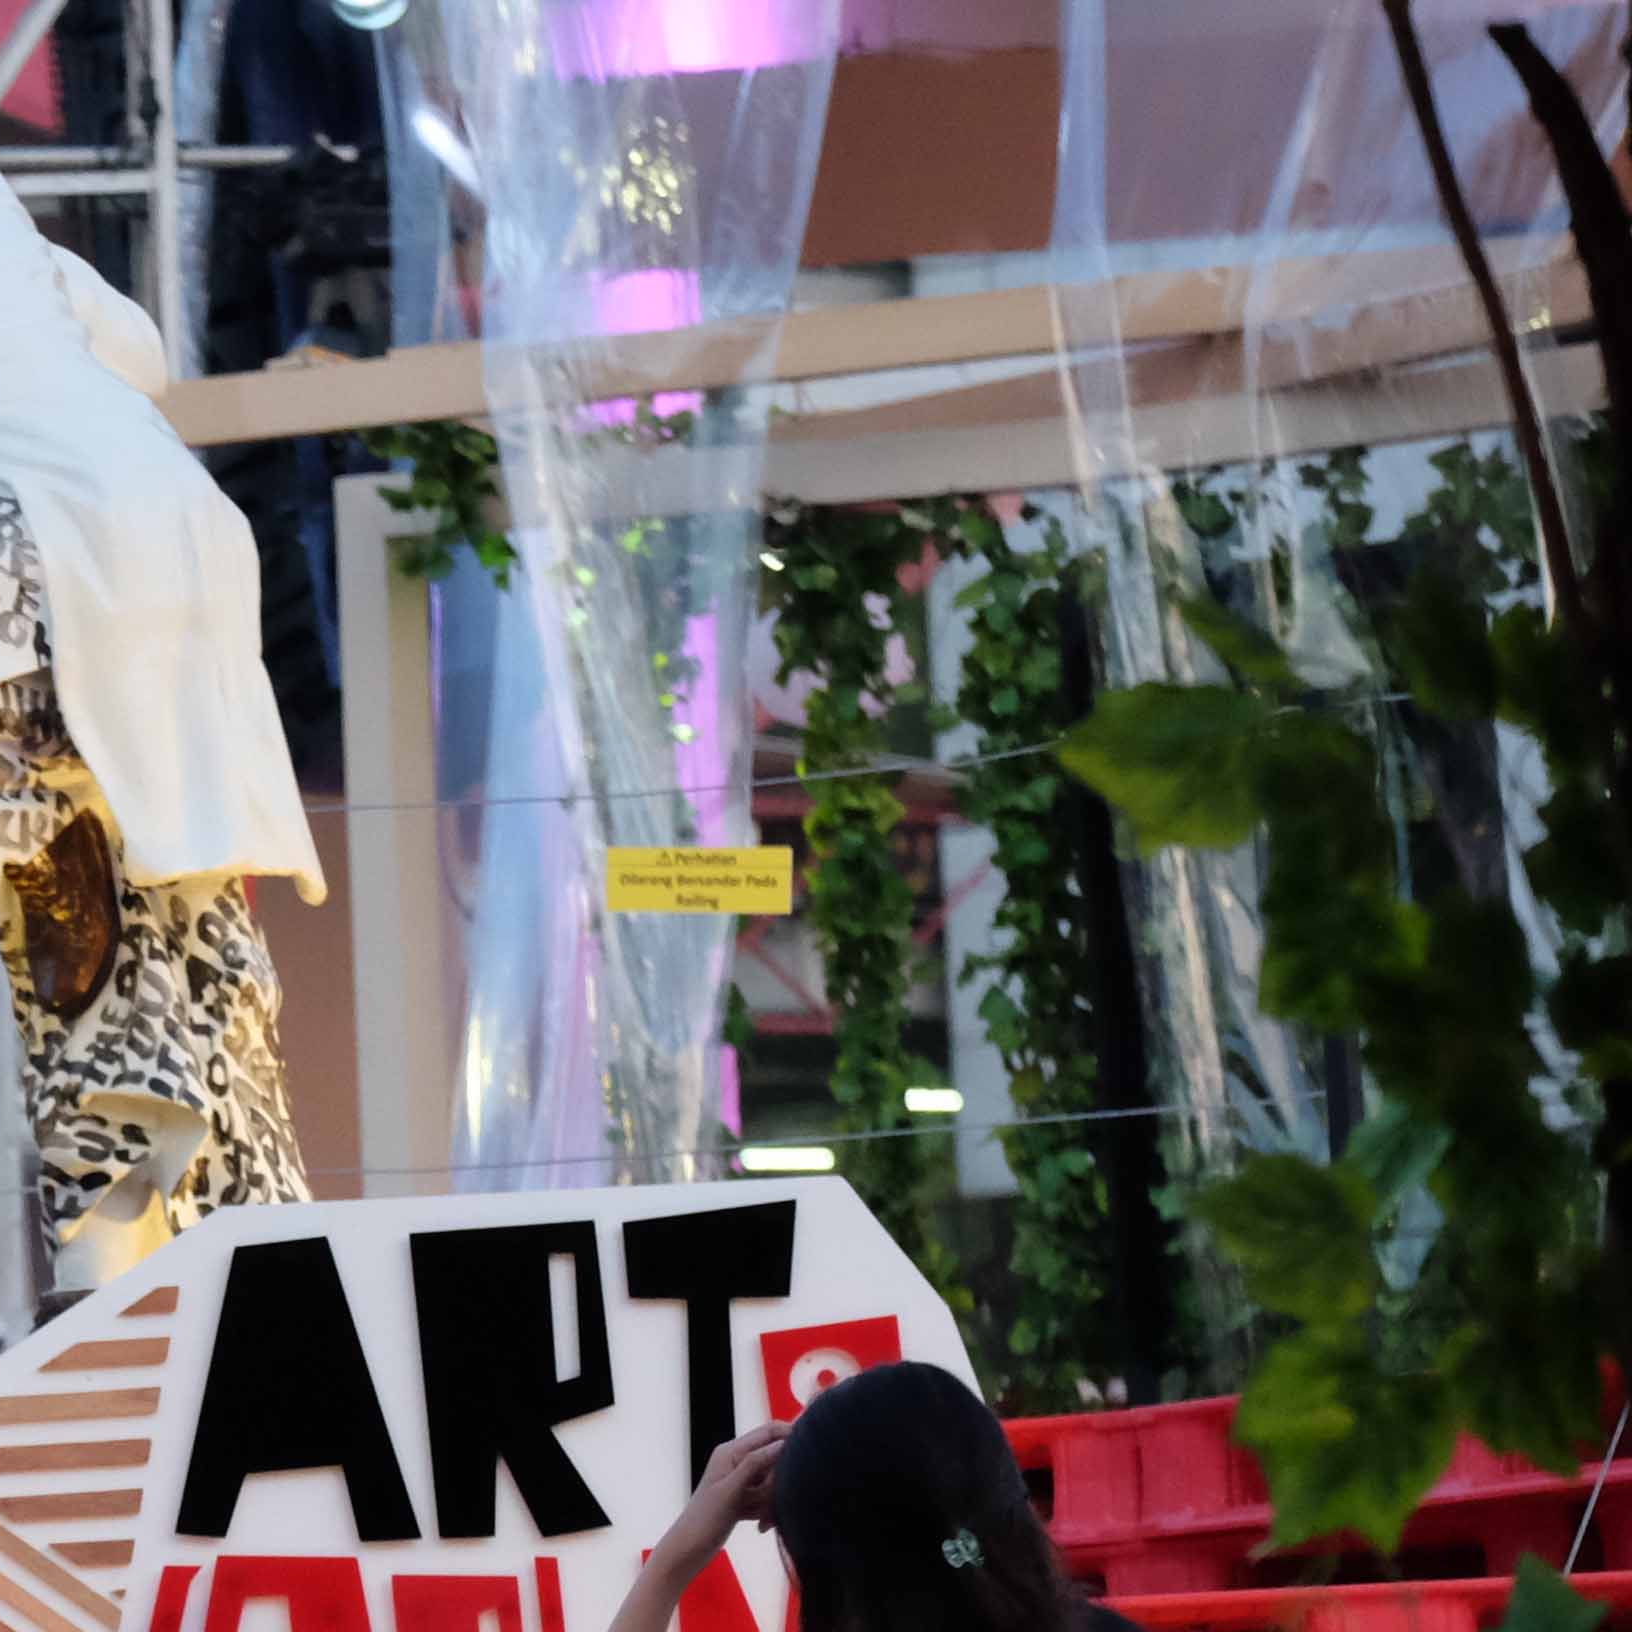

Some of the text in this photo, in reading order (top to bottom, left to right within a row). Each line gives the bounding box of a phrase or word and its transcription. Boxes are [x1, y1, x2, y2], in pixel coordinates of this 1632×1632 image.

[674, 852, 737, 866] Perhatian
[619, 873, 778, 889] Dilarang Bersandar Pada
[676, 894, 721, 910] Railing
[174, 1199, 797, 1541] ART
